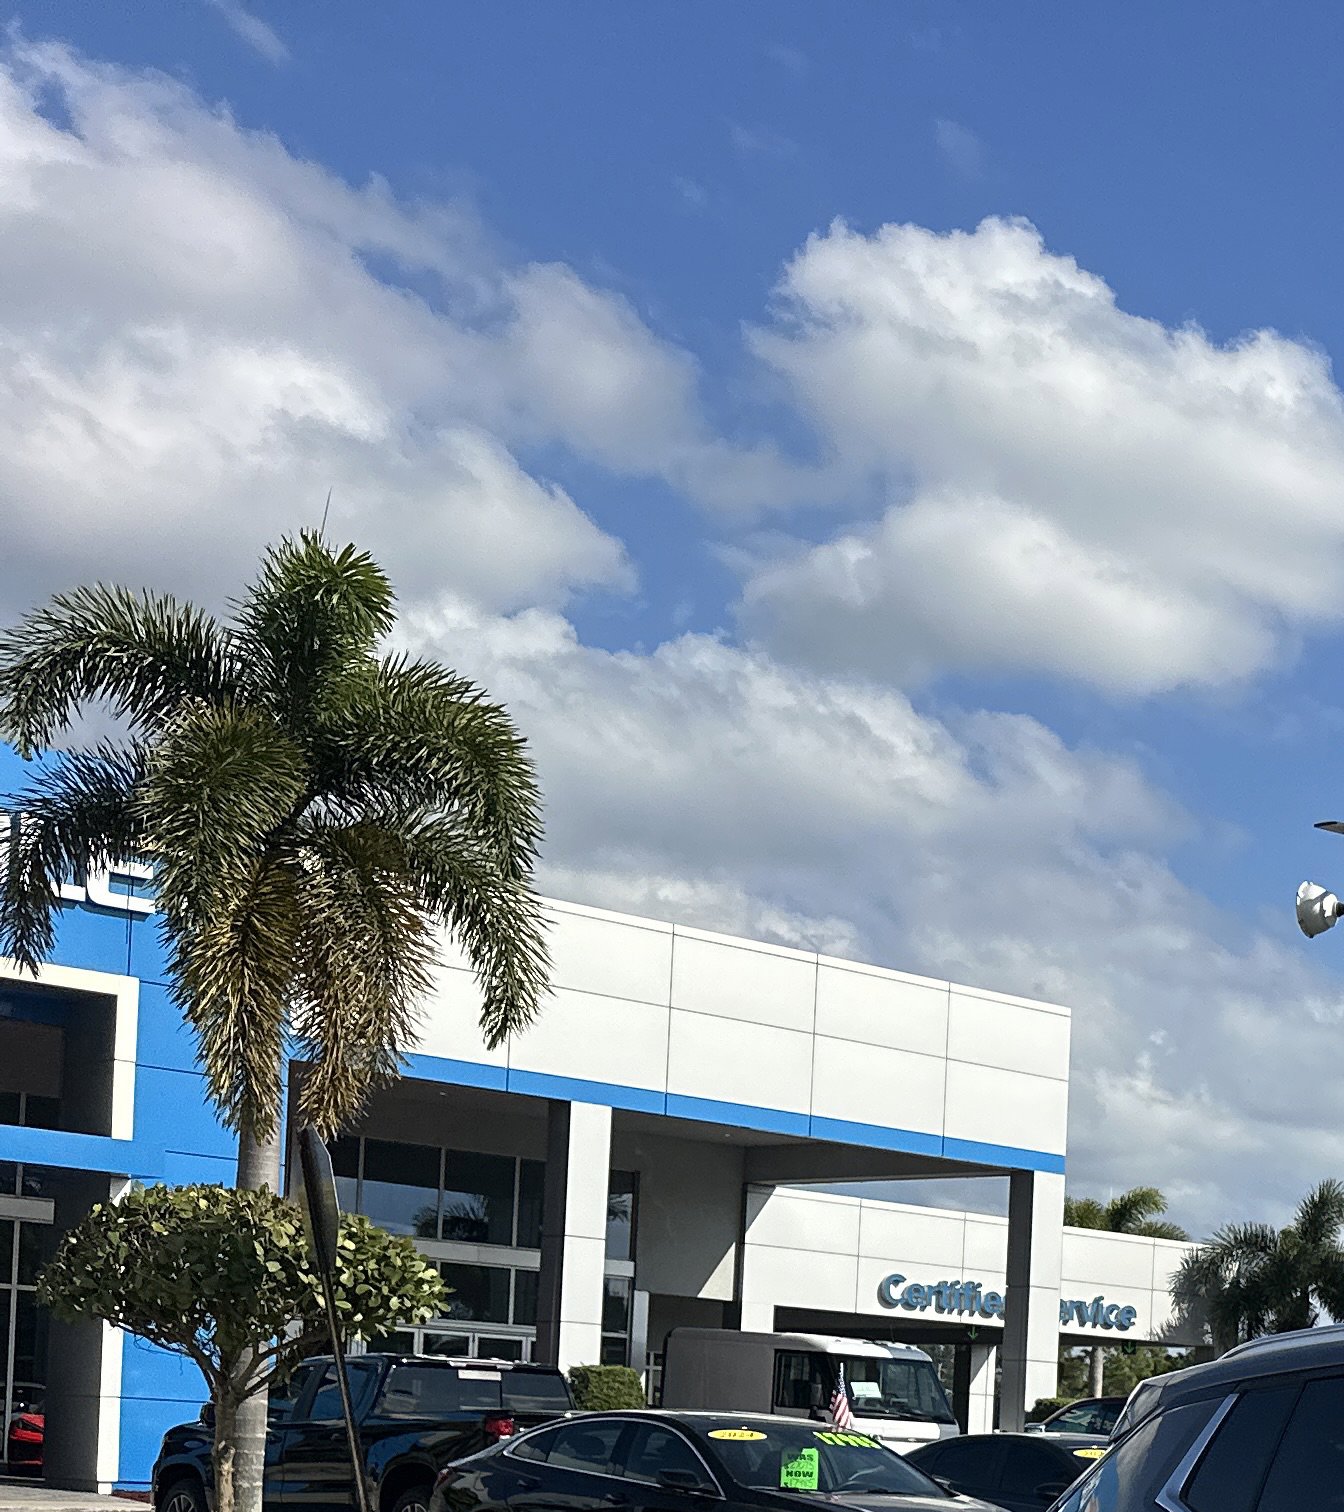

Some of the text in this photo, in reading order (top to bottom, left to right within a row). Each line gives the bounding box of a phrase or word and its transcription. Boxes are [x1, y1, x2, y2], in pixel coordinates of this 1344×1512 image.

[878, 1273, 1137, 1331] Certifie rvice
[785, 1470, 814, 1478] NOW
